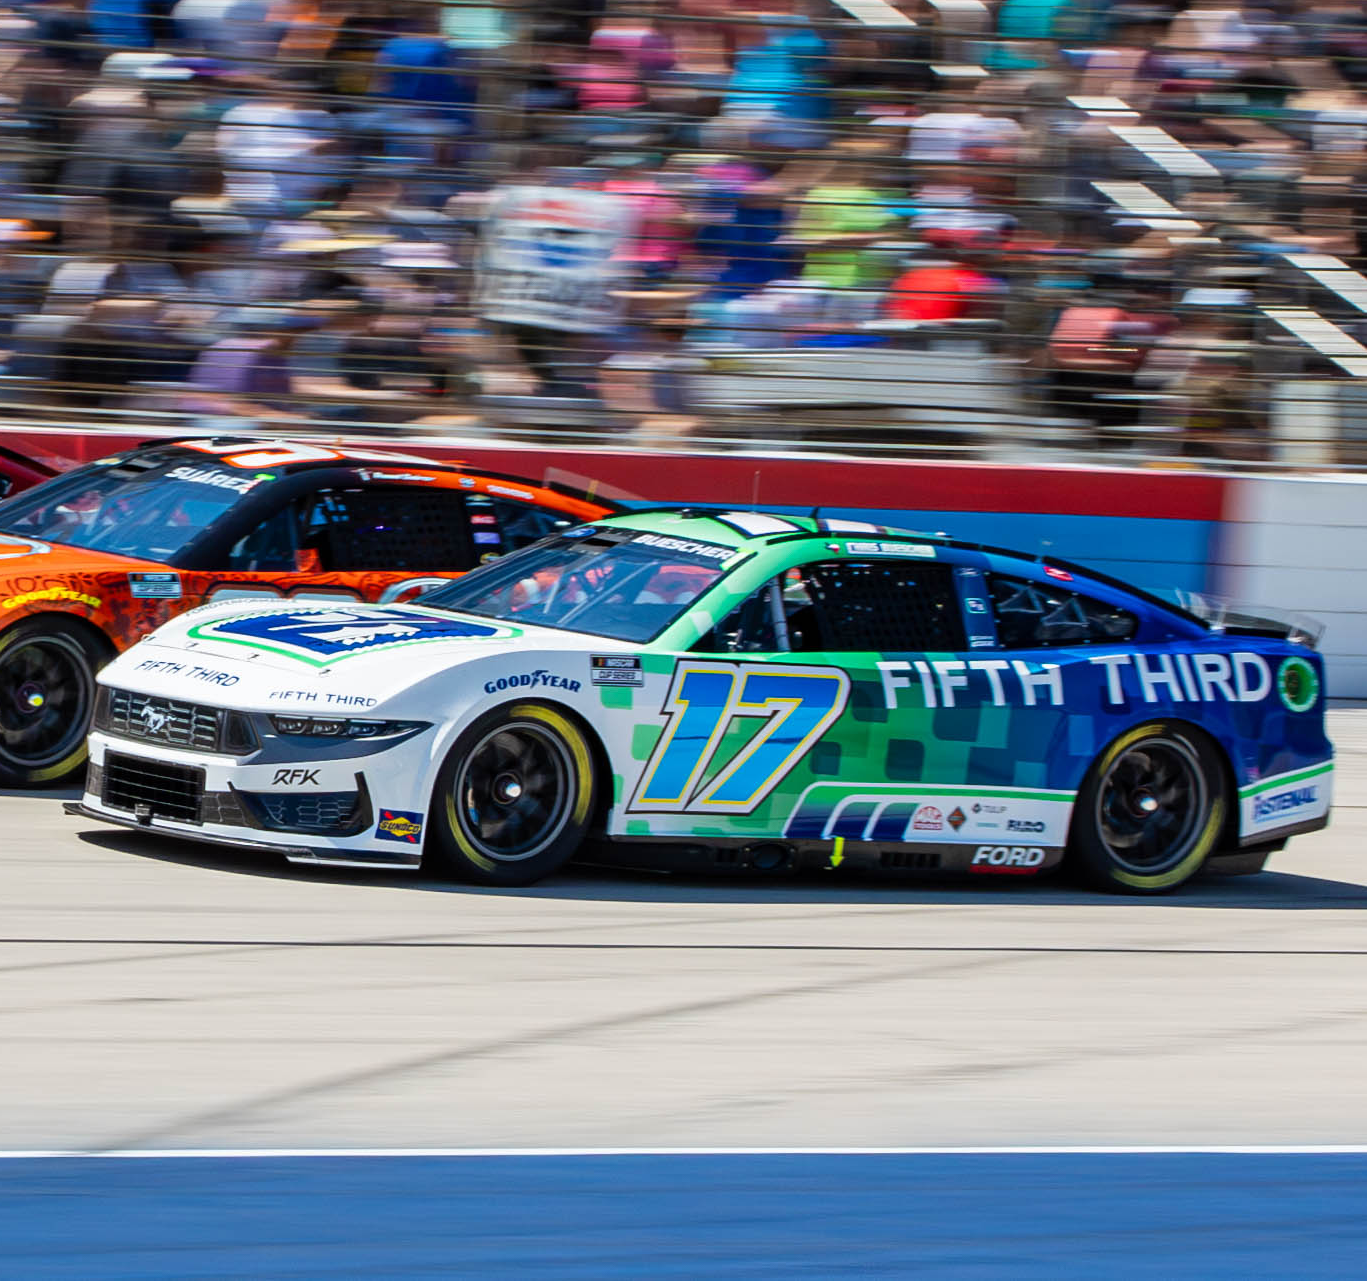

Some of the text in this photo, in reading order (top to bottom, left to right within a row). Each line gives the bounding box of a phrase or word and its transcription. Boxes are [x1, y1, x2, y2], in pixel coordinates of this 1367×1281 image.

[631, 534, 737, 560] BUESCHER
[2, 586, 102, 608] GOODYEAR
[134, 660, 240, 687] FIFTH THIRD
[484, 669, 582, 694] GOODYEAR
[877, 659, 1064, 709] FIFTH
[1090, 652, 1272, 705] THIRD
[269, 690, 378, 707] FIFTH THIRD
[627, 660, 851, 815] 17
[272, 769, 322, 785] RFK
[971, 846, 1046, 866] FORD
